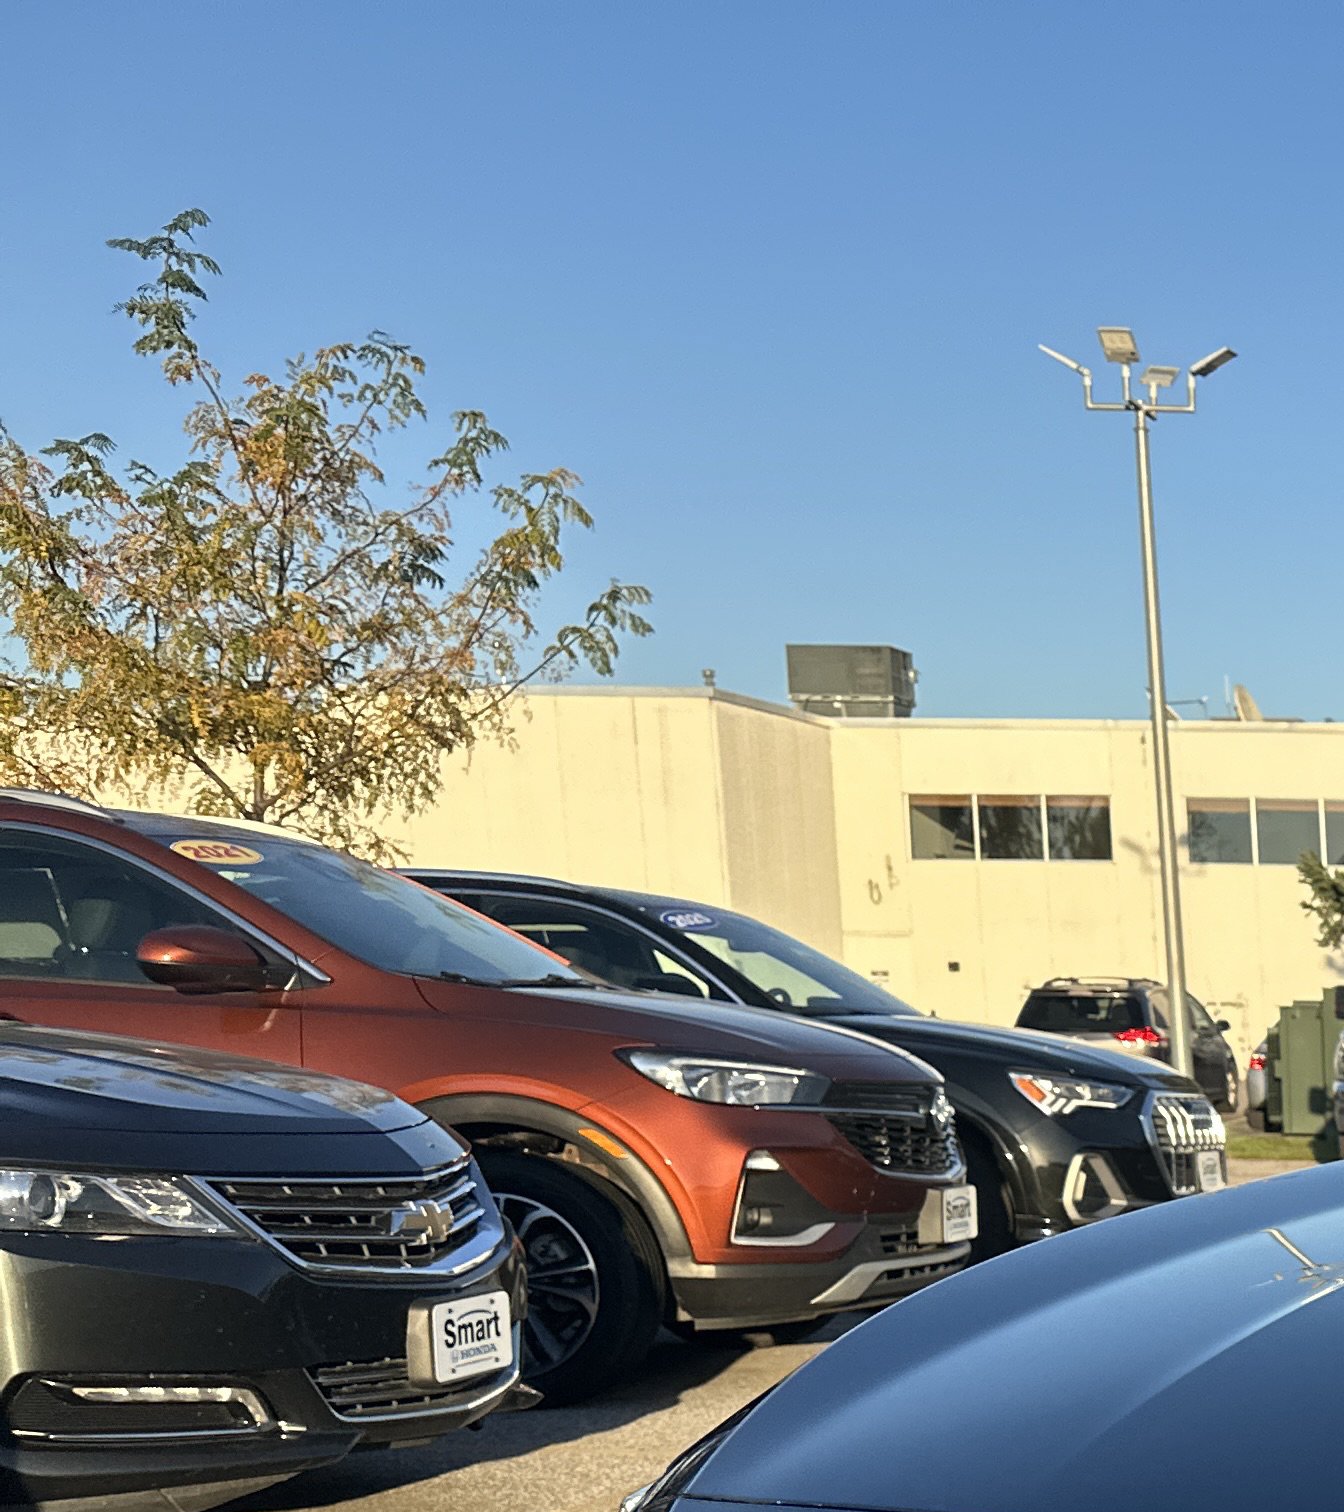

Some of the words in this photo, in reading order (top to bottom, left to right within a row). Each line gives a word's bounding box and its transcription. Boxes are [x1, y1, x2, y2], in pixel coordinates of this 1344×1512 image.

[181, 845, 253, 859] 2021
[444, 1311, 501, 1349] Smart
[461, 1343, 497, 1359] HONDA
